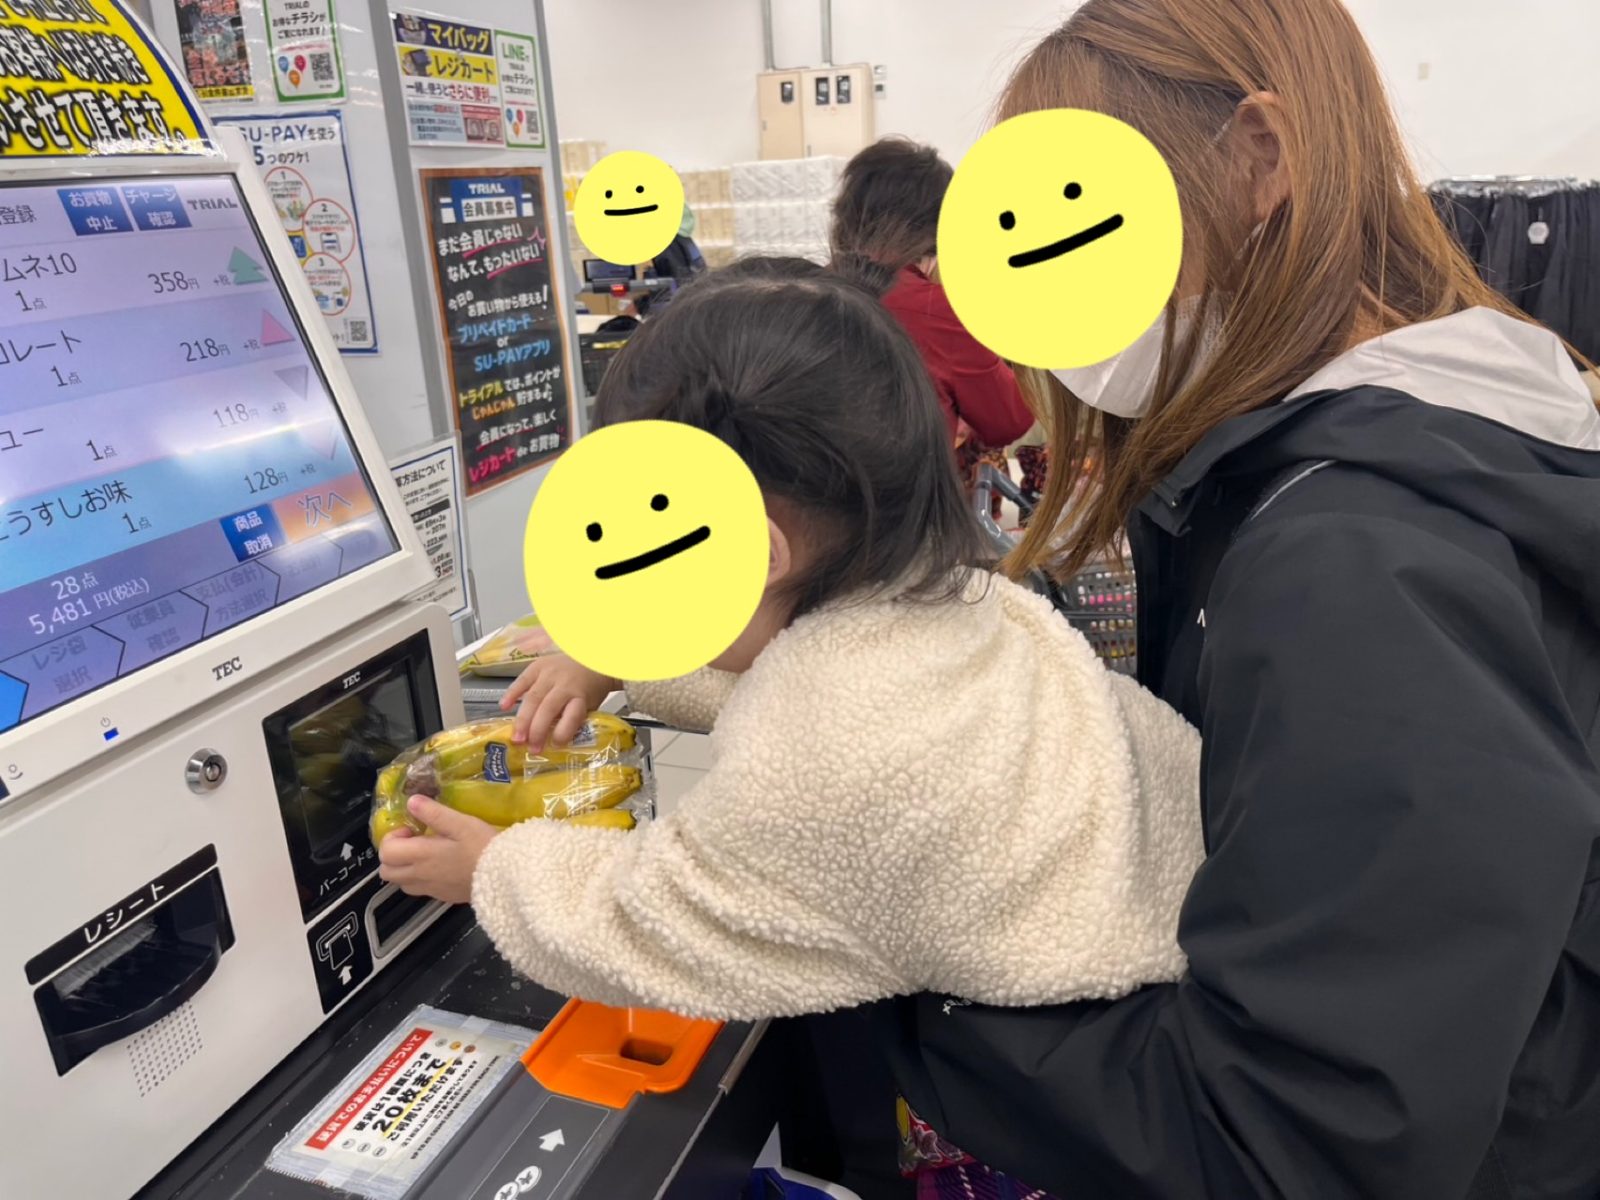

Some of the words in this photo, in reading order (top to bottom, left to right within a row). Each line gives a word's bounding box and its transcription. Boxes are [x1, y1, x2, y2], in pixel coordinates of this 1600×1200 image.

[427, 23, 489, 52] マイバッグ
[434, 55, 494, 82] レジカート
[68, 190, 113, 207] お買物
[125, 188, 177, 204] チャージ
[468, 183, 505, 194] TRIAL
[187, 198, 238, 210] TRIAL
[464, 200, 515, 217] 会員募集中
[86, 215, 118, 231] 中止
[146, 211, 176, 227] 確認
[438, 223, 523, 256] まだ会員じゃない
[3, 252, 77, 281] ムネ10
[447, 290, 474, 312] 今日の
[497, 335, 510, 348] or
[232, 510, 263, 533] 商品
[297, 492, 351, 529] 次へ
[243, 533, 273, 556] 取消
[212, 656, 243, 681] TEC
[342, 671, 361, 689] TEC
[84, 884, 164, 943] レシート
[316, 1034, 423, 1141] 硬貨でのお支払いについて
[372, 1058, 446, 1133] 20枚まで
